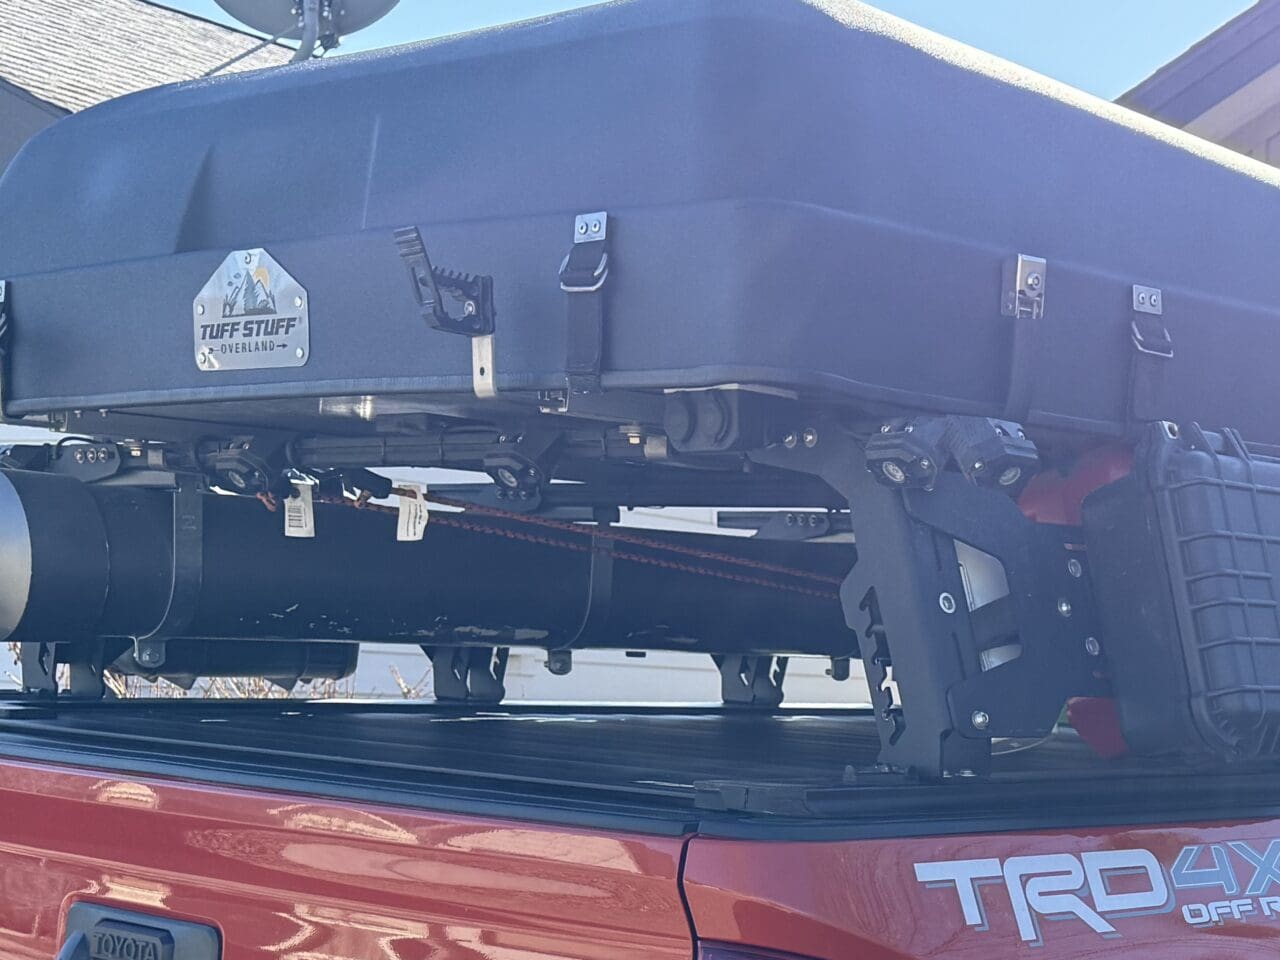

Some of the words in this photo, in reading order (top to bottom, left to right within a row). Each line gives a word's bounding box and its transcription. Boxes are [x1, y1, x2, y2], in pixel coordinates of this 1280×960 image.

[200, 321, 241, 340] TUFF
[242, 317, 297, 338] STUFF
[221, 340, 275, 354] OVERLAND
[914, 848, 1175, 944] TRD
[1182, 898, 1257, 926] OFF
